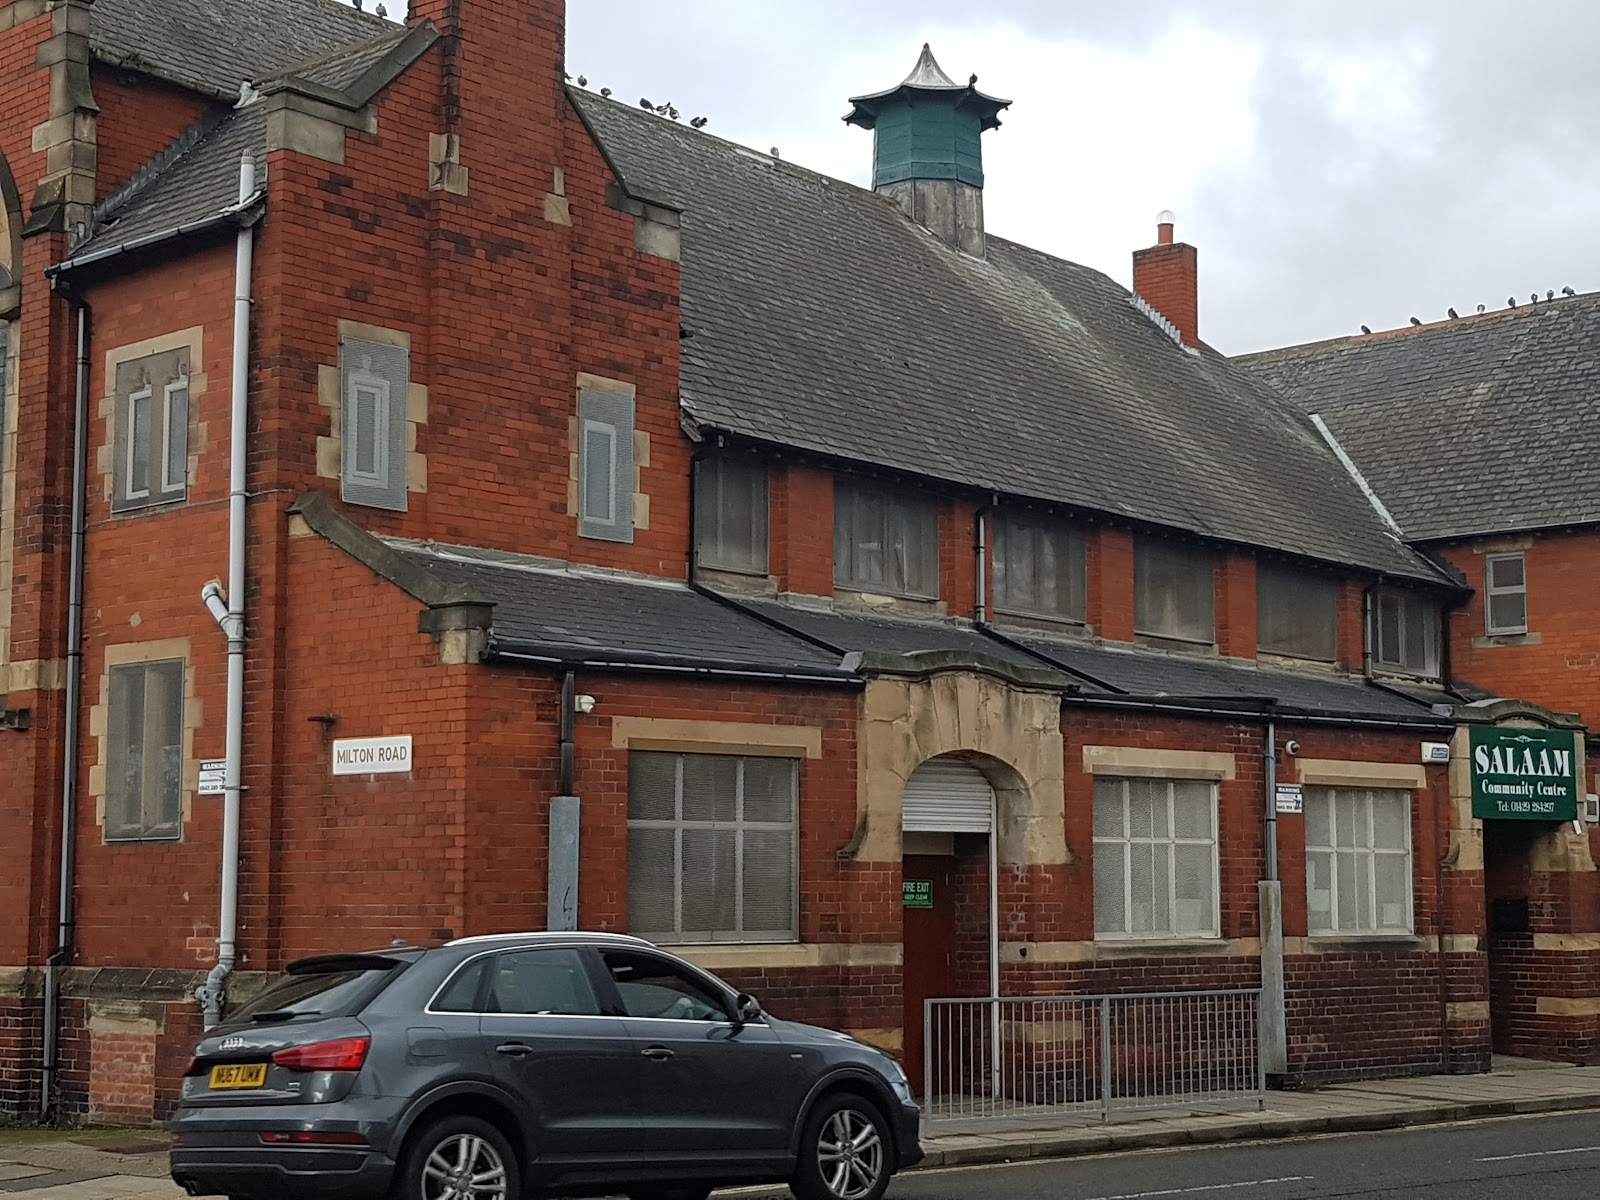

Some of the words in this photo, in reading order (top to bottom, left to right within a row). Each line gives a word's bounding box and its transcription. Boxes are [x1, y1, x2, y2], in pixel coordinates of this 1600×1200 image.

[337, 748, 374, 764] MILTON
[378, 746, 407, 762] ROAD
[1475, 744, 1571, 777] SALAAM
[1481, 779, 1535, 798] Community
[1537, 781, 1567, 796] Centre
[902, 882, 916, 892] FIRE
[916, 882, 930, 892] EXIT
